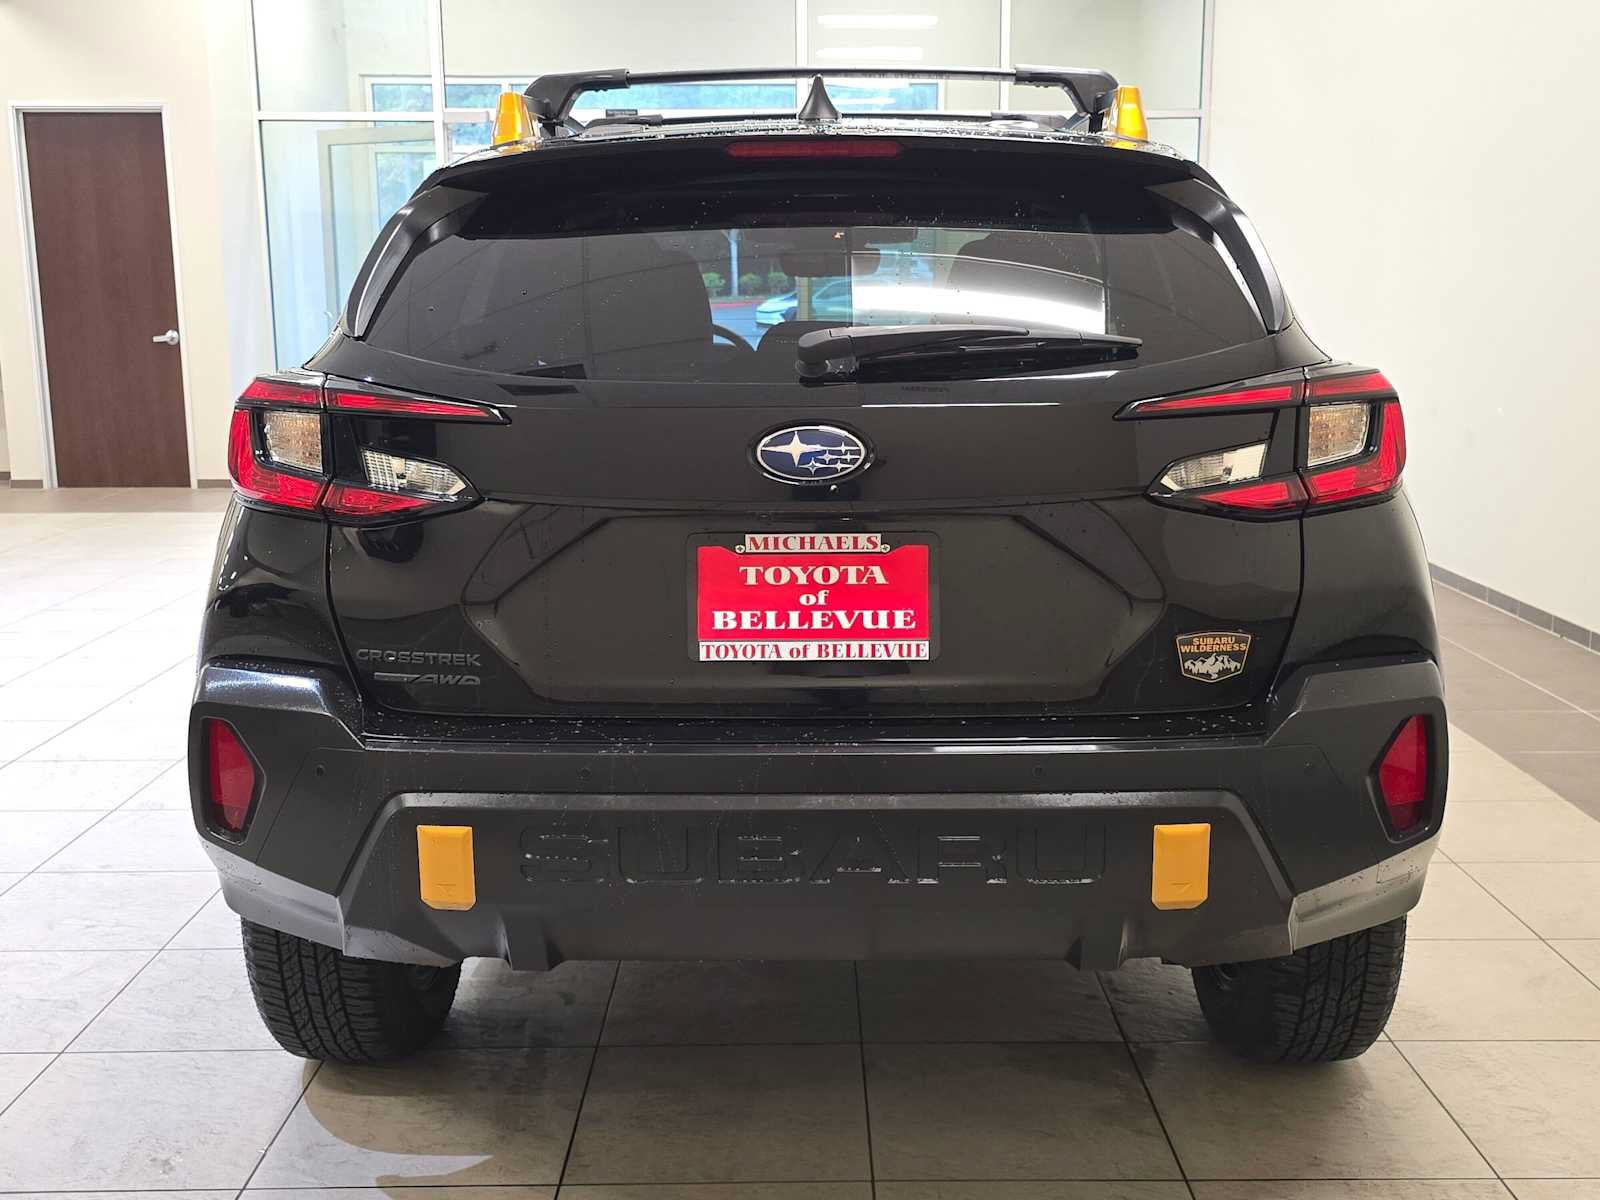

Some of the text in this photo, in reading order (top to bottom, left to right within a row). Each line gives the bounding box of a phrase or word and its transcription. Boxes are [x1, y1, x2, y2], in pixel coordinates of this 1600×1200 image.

[749, 535, 880, 551] MICHAELS
[739, 566, 889, 586] TOYOTA
[799, 590, 830, 606] of
[712, 608, 917, 631] BELLEVUE
[1180, 643, 1248, 653] WILDERNESS
[1192, 636, 1236, 646] SUBARU
[355, 648, 482, 667] CROSSTREK
[700, 642, 928, 660] TOYOTA of BELLEVUE
[519, 823, 1106, 886] SUBARU
